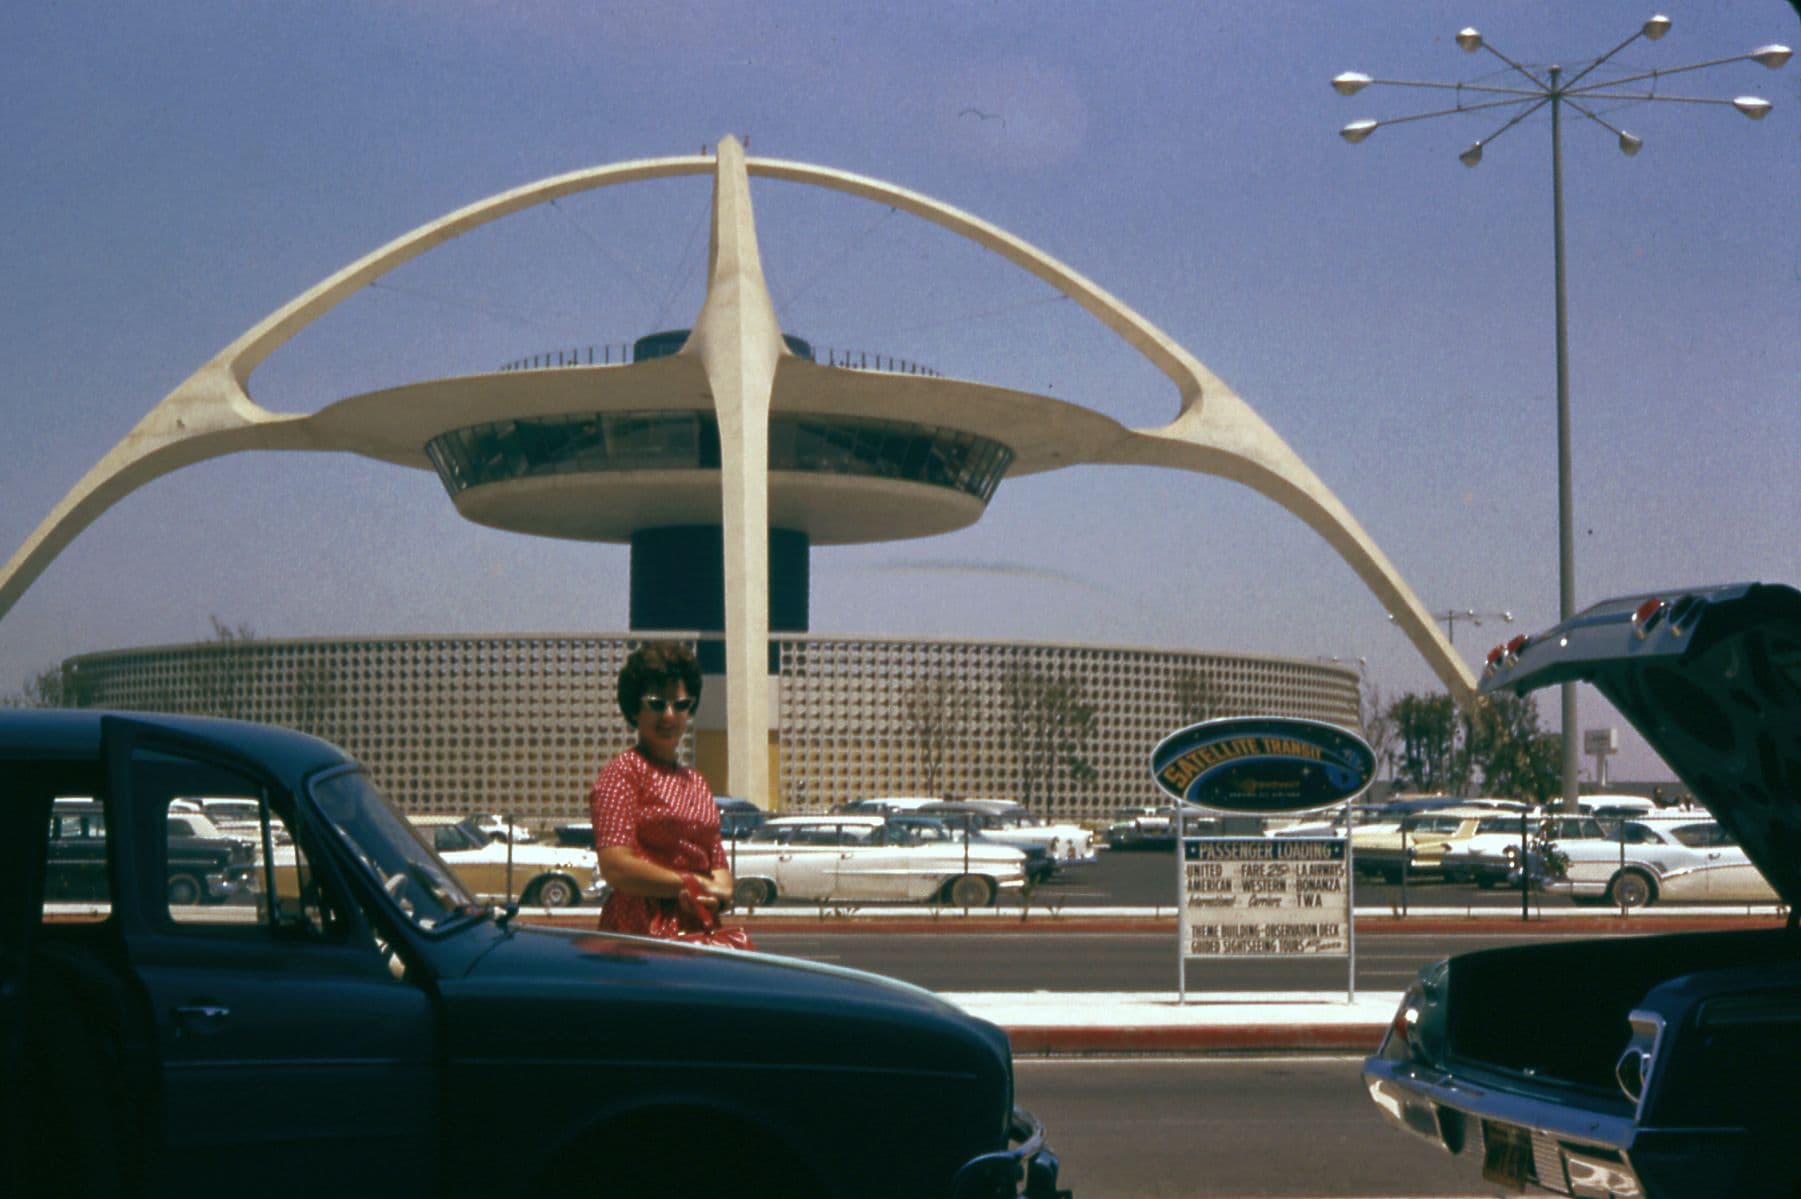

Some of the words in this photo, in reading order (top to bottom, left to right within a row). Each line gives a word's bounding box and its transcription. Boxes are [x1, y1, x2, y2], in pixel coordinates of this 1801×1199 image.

[1163, 736, 1260, 789] SATELLITE
[1262, 736, 1323, 760] TRANSIT
[1199, 842, 1273, 859] PASSENGER
[1277, 842, 1331, 859] LOADING
[1187, 864, 1223, 877] UNITED
[1241, 864, 1265, 877] FARE
[1187, 879, 1232, 893] AMERICAN
[1242, 879, 1287, 893] WESTERN
[1296, 879, 1341, 892] BONANZA
[1296, 894, 1323, 907] TWA
[1319, 924, 1339, 937] DECK
[1191, 940, 1220, 953] GUIDED
[1223, 940, 1276, 953] SIGHTSEEING
